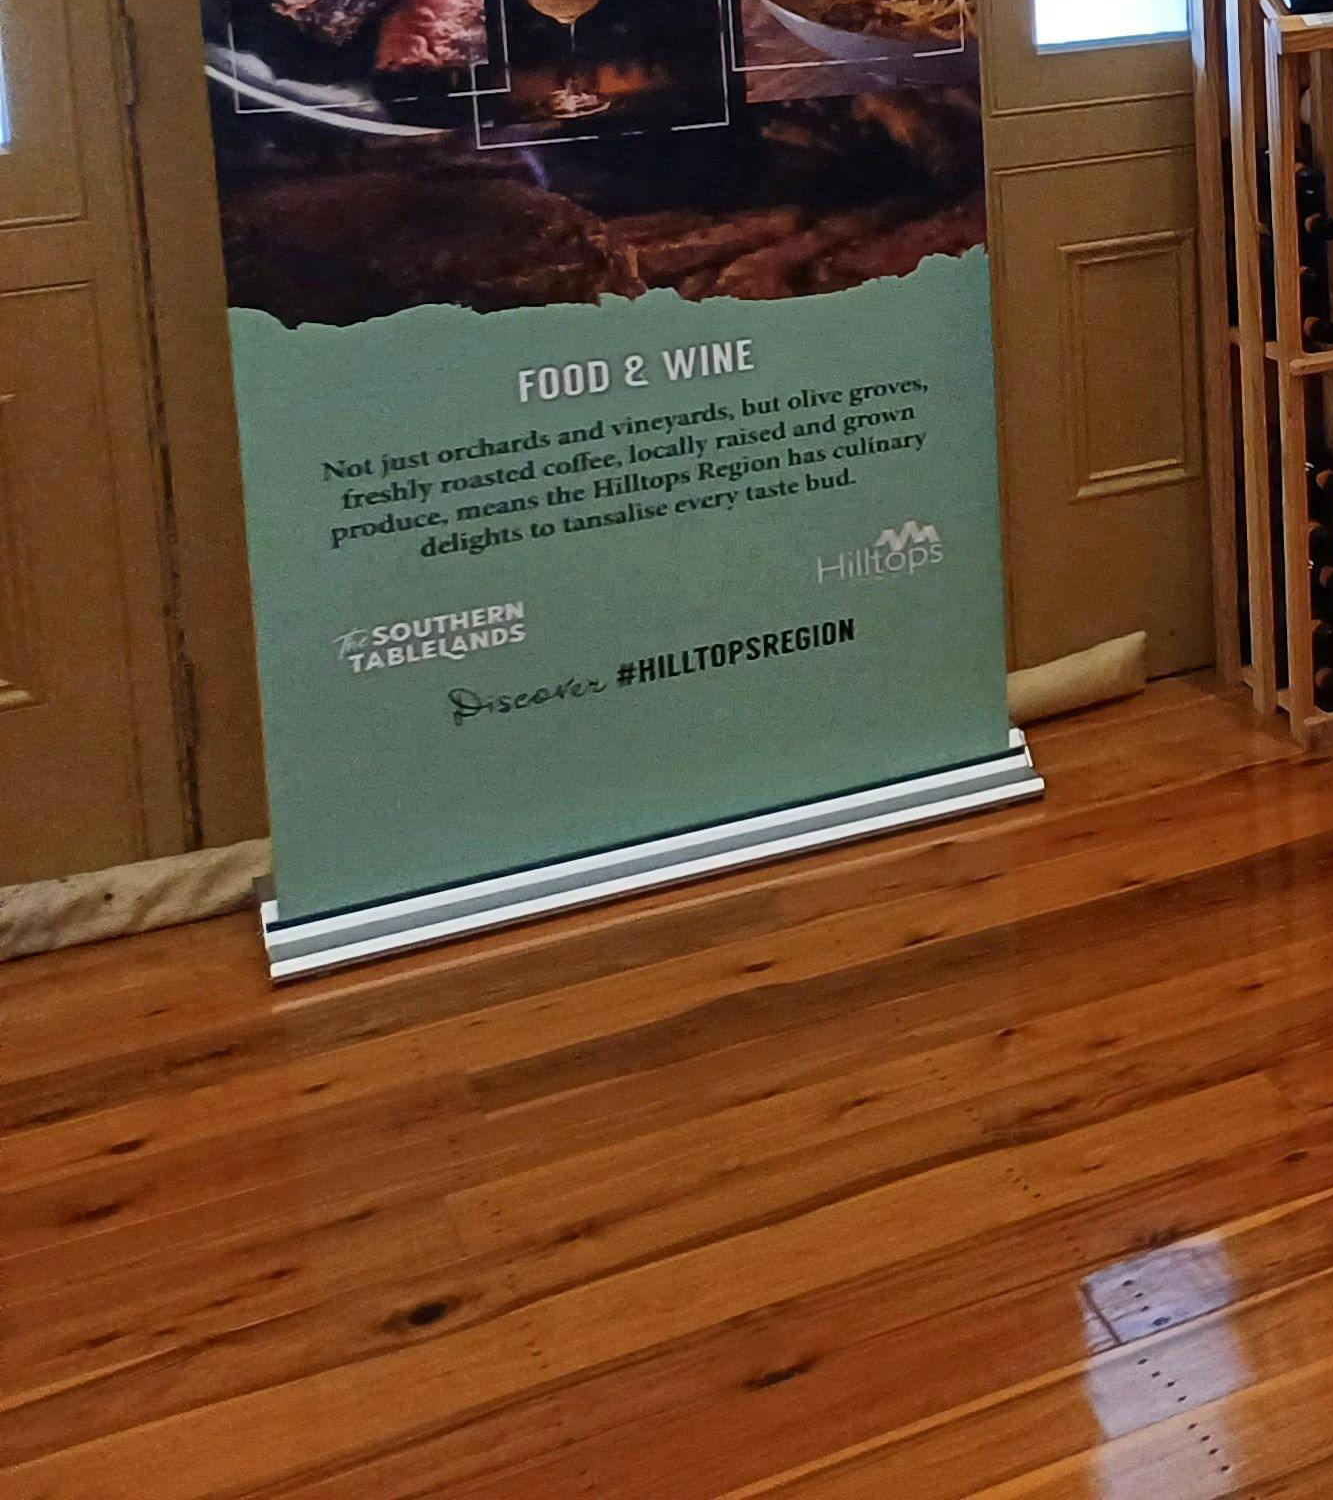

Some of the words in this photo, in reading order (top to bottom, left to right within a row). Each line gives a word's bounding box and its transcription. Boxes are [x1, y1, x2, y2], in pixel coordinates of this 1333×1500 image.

[518, 360, 610, 403] FOOD
[624, 355, 649, 387] &
[662, 339, 754, 381] WINE
[322, 459, 374, 481] Not
[381, 449, 431, 479] just
[437, 430, 551, 464] orchards
[558, 420, 604, 445] and
[611, 403, 735, 438] vineyards,
[741, 396, 781, 417] but
[787, 386, 843, 409] olive
[849, 376, 929, 407] groves,
[340, 479, 434, 511] freshly
[440, 461, 536, 494] roasted
[543, 451, 623, 477] coffee,
[629, 434, 709, 464] locally
[716, 421, 787, 450] raised
[793, 414, 836, 438] and
[843, 406, 915, 436] grown
[330, 512, 449, 550] produce,
[456, 494, 539, 521] means
[546, 486, 587, 506] the
[593, 470, 692, 500] Hilltops
[697, 456, 781, 483] Region
[787, 449, 827, 468] has
[832, 431, 928, 460] culinary
[420, 527, 524, 557] delights
[530, 521, 556, 539] to
[563, 502, 669, 534] tansalise
[674, 489, 739, 511] every
[746, 480, 800, 501] taste
[806, 468, 857, 493] bud.
[817, 542, 944, 584] Hilltops
[348, 623, 527, 674] TABLELANDS
[372, 601, 525, 647] SOUTHERN
[448, 675, 607, 726] Discover
[616, 618, 856, 686] #HILLTOPSREGION
